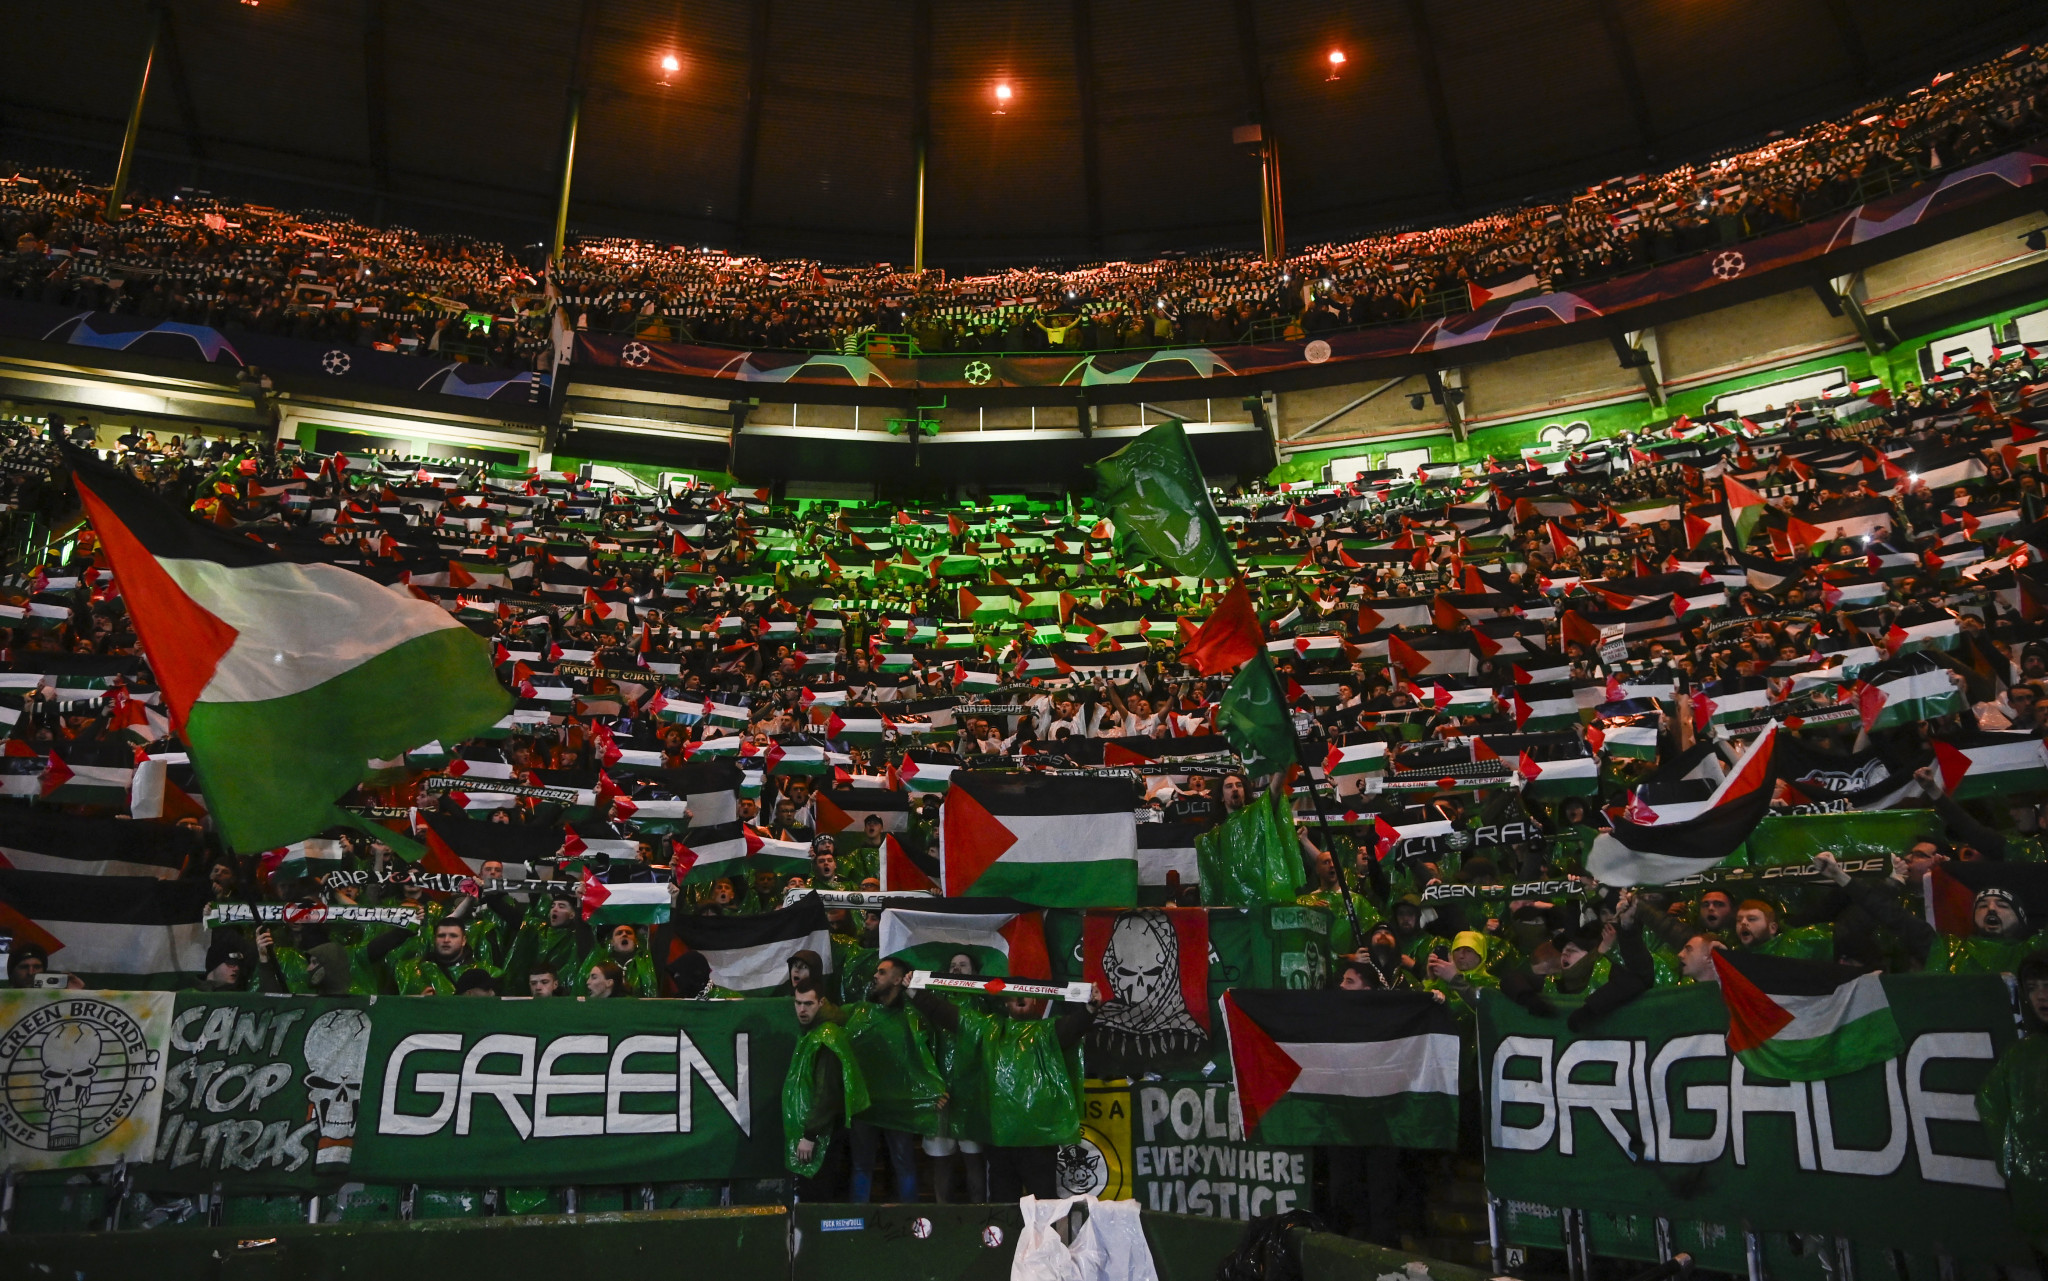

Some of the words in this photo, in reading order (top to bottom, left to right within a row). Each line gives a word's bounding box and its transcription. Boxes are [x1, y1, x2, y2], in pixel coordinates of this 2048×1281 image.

[1811, 710, 1856, 723] PALESTINE
[1464, 777, 1506, 785] PALESTINE
[932, 978, 977, 988] PALESTINE
[1012, 984, 1060, 994] PALESTINE
[0, 1005, 63, 1059] GREEN
[70, 1001, 144, 1055] BRIGADE
[171, 1006, 306, 1058] CANT
[163, 1056, 294, 1113] STOP
[377, 1029, 751, 1142] GREEN
[93, 1092, 134, 1135] CREW
[1491, 1031, 2006, 1190] BRIGADE
[1135, 1144, 1306, 1185] EVERYWHERE
[1509, 1250, 1520, 1264] A
